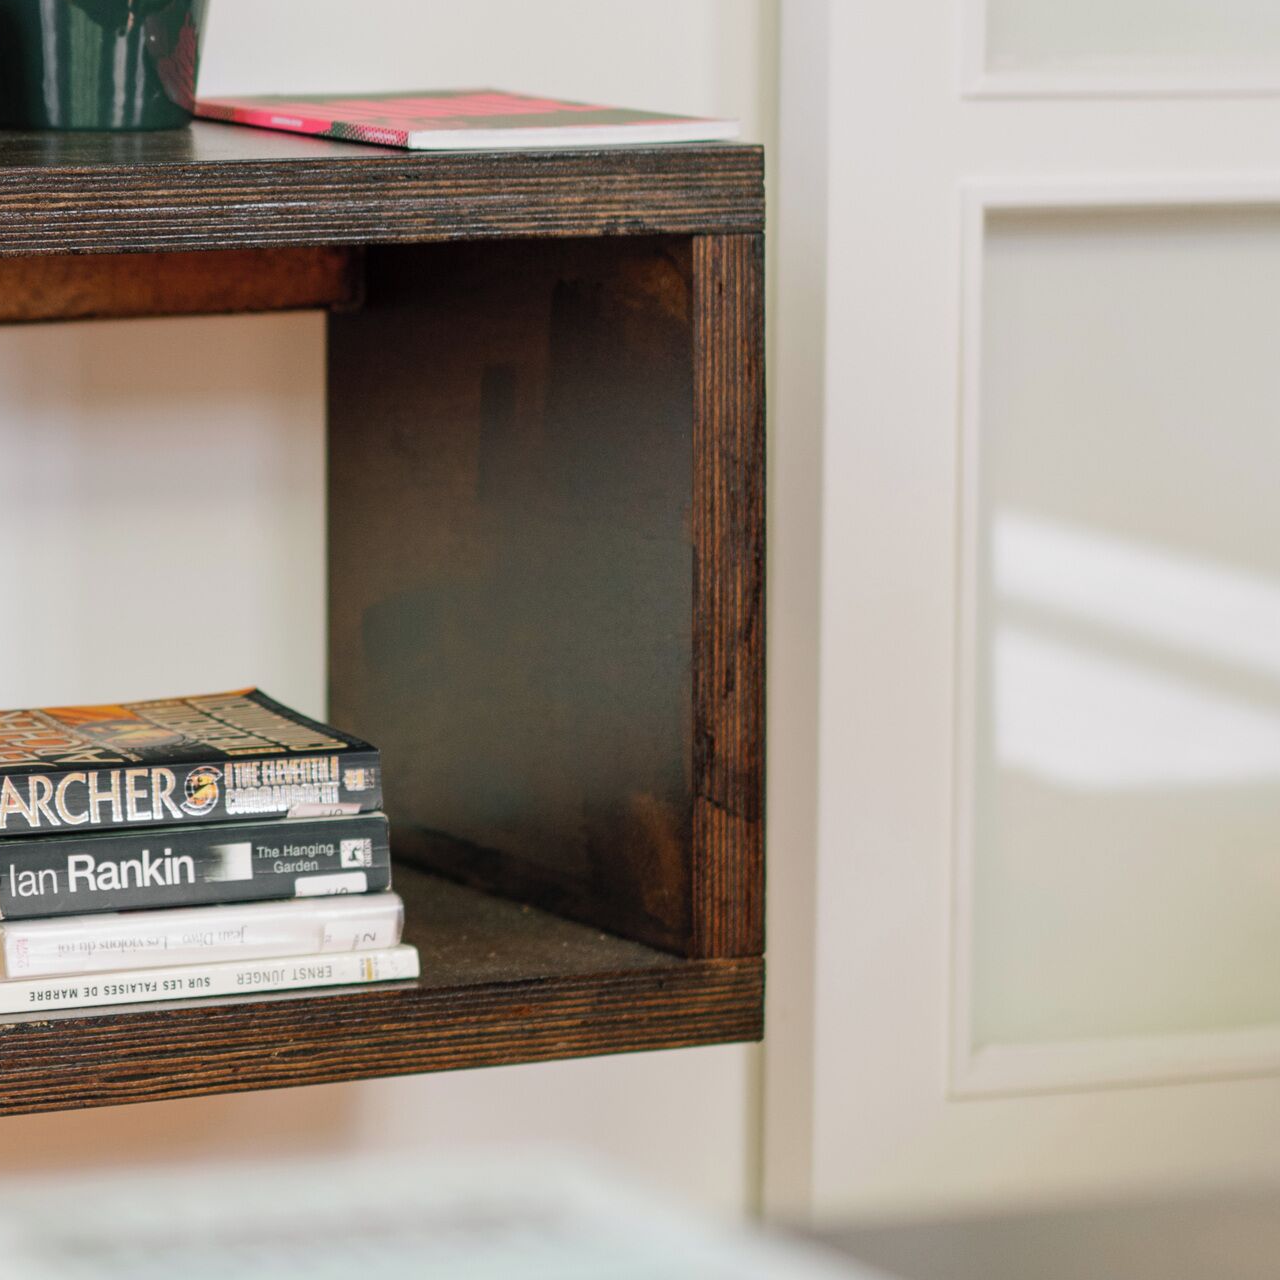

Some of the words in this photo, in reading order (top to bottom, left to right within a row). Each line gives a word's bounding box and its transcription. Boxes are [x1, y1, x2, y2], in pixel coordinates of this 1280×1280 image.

[257, 846, 280, 858] The
[283, 843, 335, 857] Hanging
[9, 864, 58, 897] Ian
[68, 848, 195, 893] Rankin
[273, 860, 319, 873] Garden
[144, 934, 168, 946] Les
[79, 941, 97, 956] du
[292, 965, 333, 980] ERNST
[163, 978, 183, 990] LES
[188, 976, 210, 988] SUR
[29, 989, 78, 1002] MARBRE
[84, 986, 98, 998] DE
[104, 982, 157, 996] FALAISES
